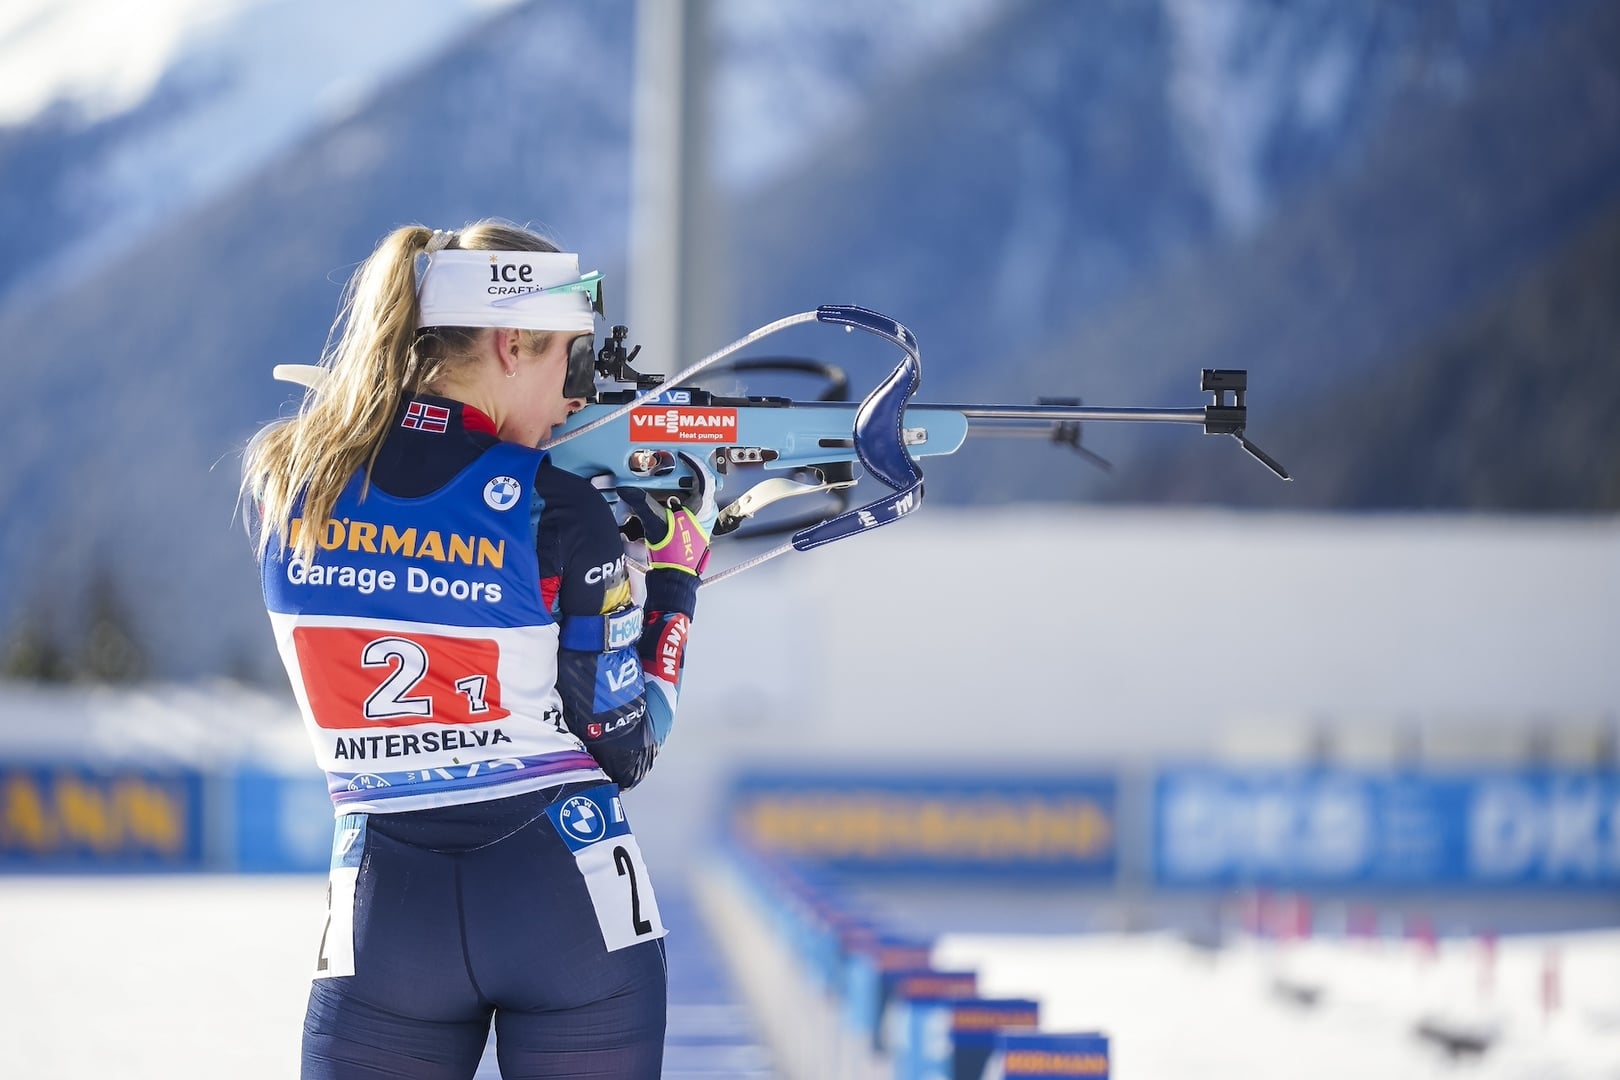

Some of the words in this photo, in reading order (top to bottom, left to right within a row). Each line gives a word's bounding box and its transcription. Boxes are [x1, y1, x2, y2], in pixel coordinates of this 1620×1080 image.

[490, 256, 533, 283] ice
[633, 410, 735, 433] VIESSMANN
[679, 432, 696, 440] Heat
[677, 516, 694, 561] LEKI
[287, 559, 397, 594] Garage
[407, 566, 503, 602] Doors
[662, 617, 687, 675] MENY
[361, 635, 434, 720] 2
[455, 674, 489, 715] 1
[334, 728, 512, 760] ANTERSELVA
[563, 799, 593, 818] BMW
[613, 846, 652, 936] 2
